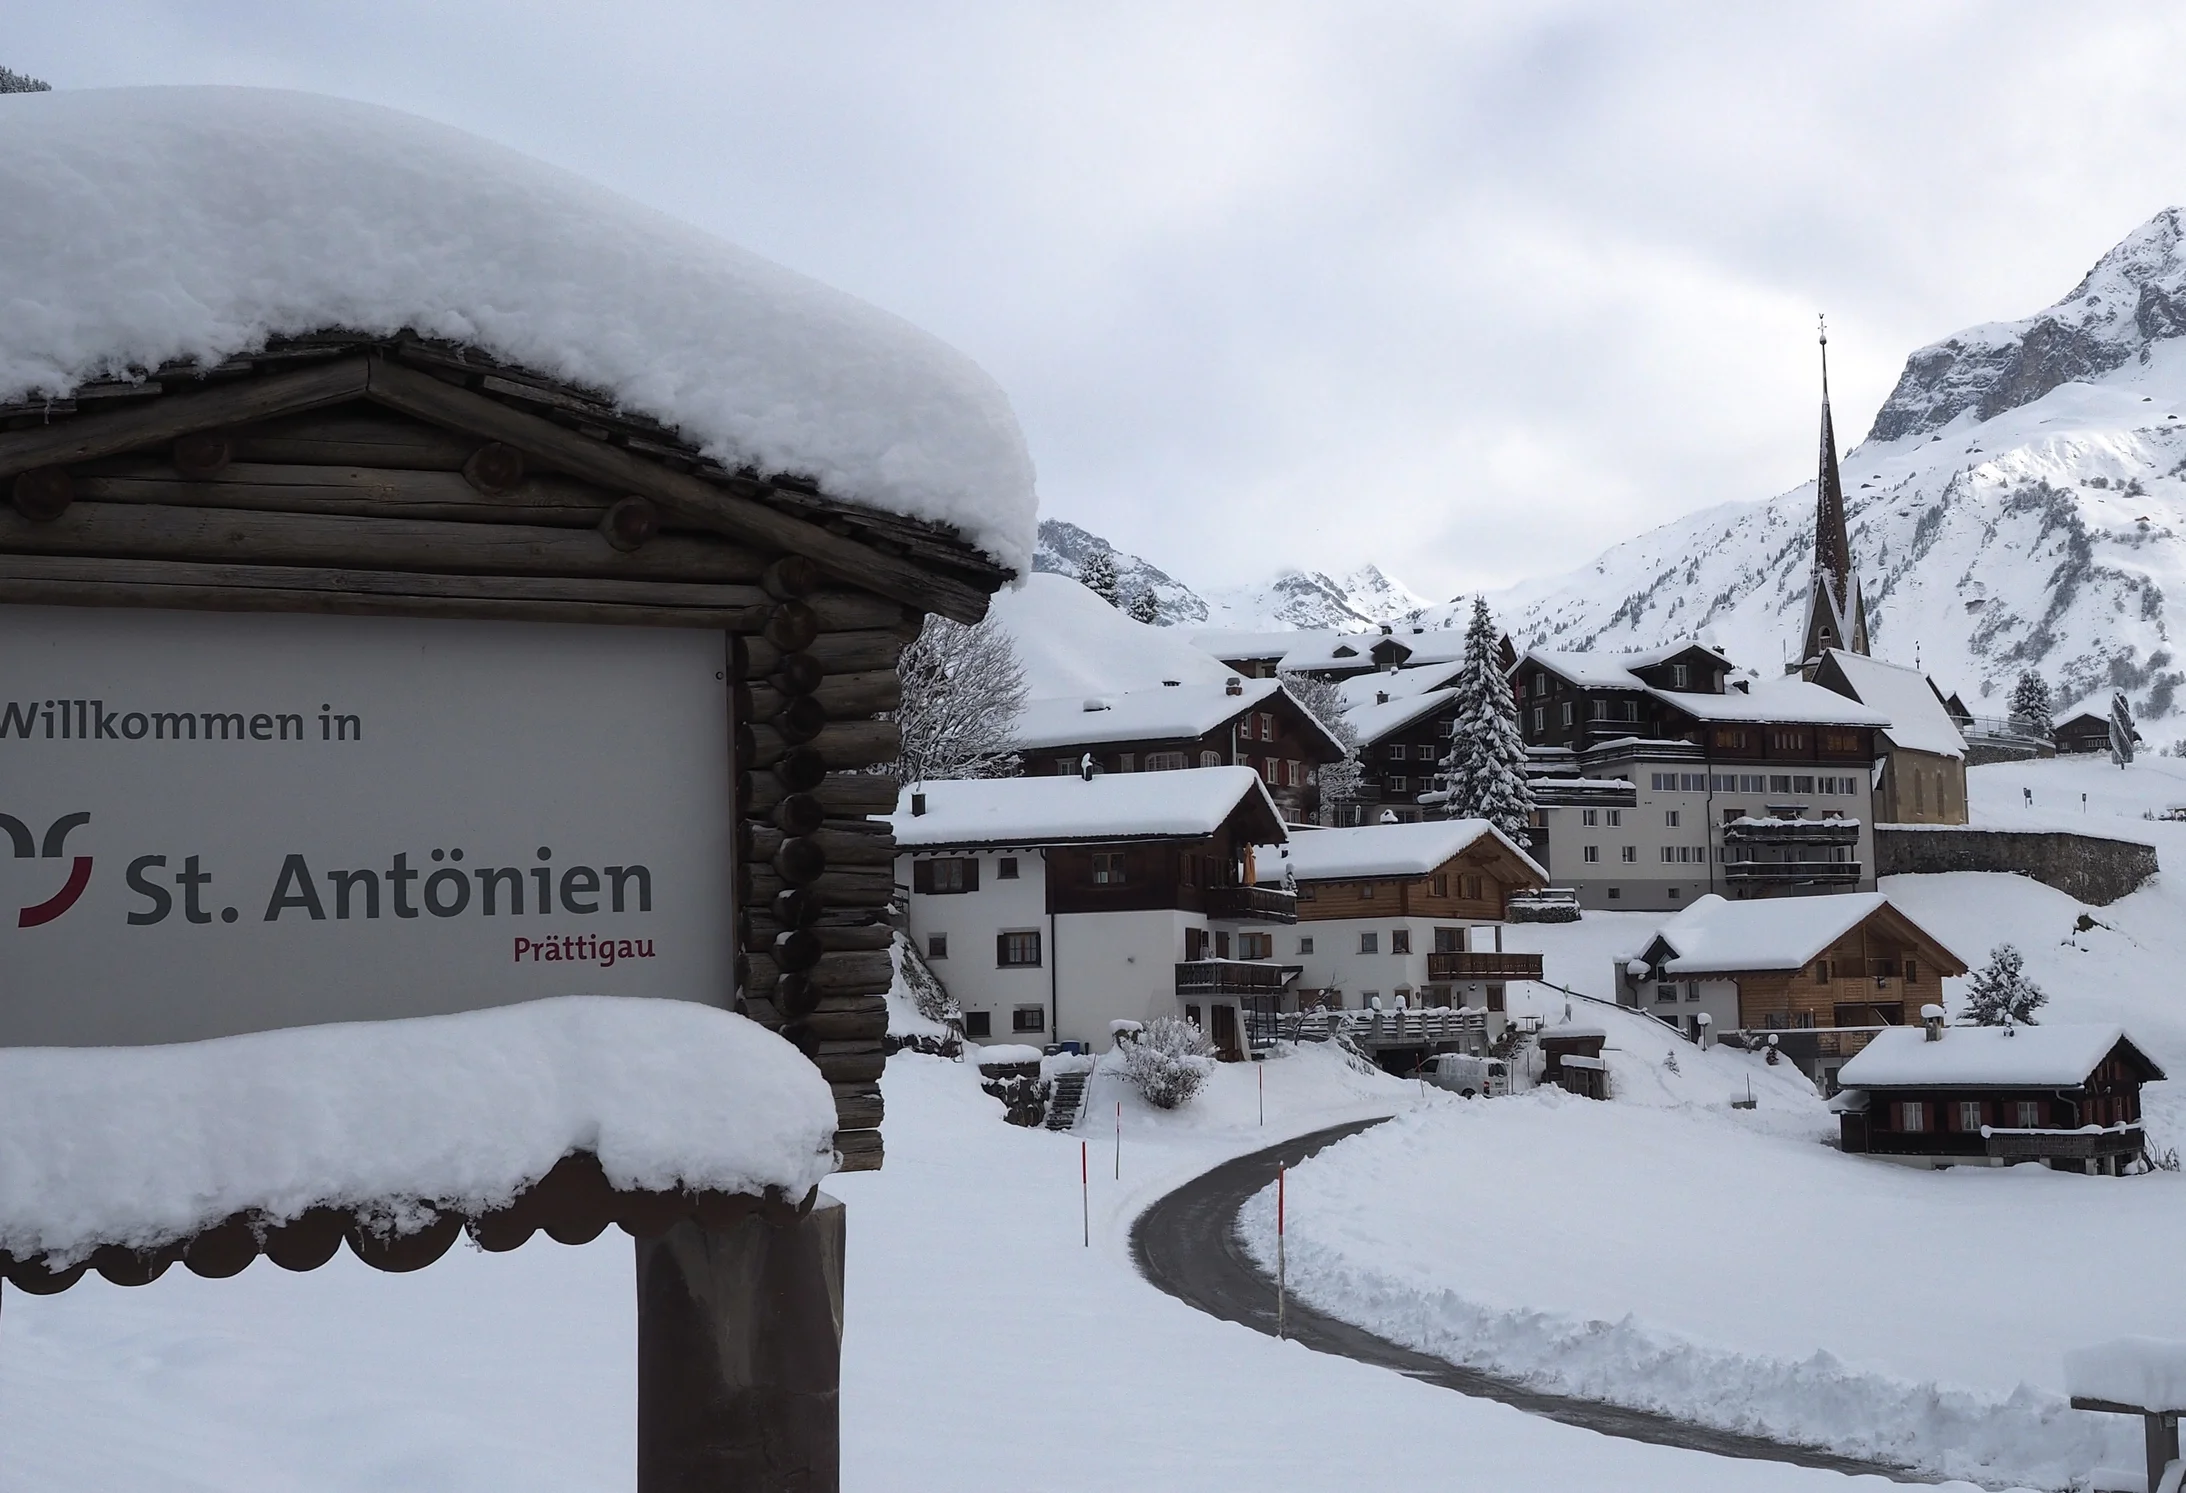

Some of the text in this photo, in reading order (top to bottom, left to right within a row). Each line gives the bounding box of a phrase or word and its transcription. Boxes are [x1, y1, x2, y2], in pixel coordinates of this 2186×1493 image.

[0, 699, 361, 741] Willkommen in
[125, 846, 652, 926] St. Antönien
[513, 935, 656, 968] Prättigau
